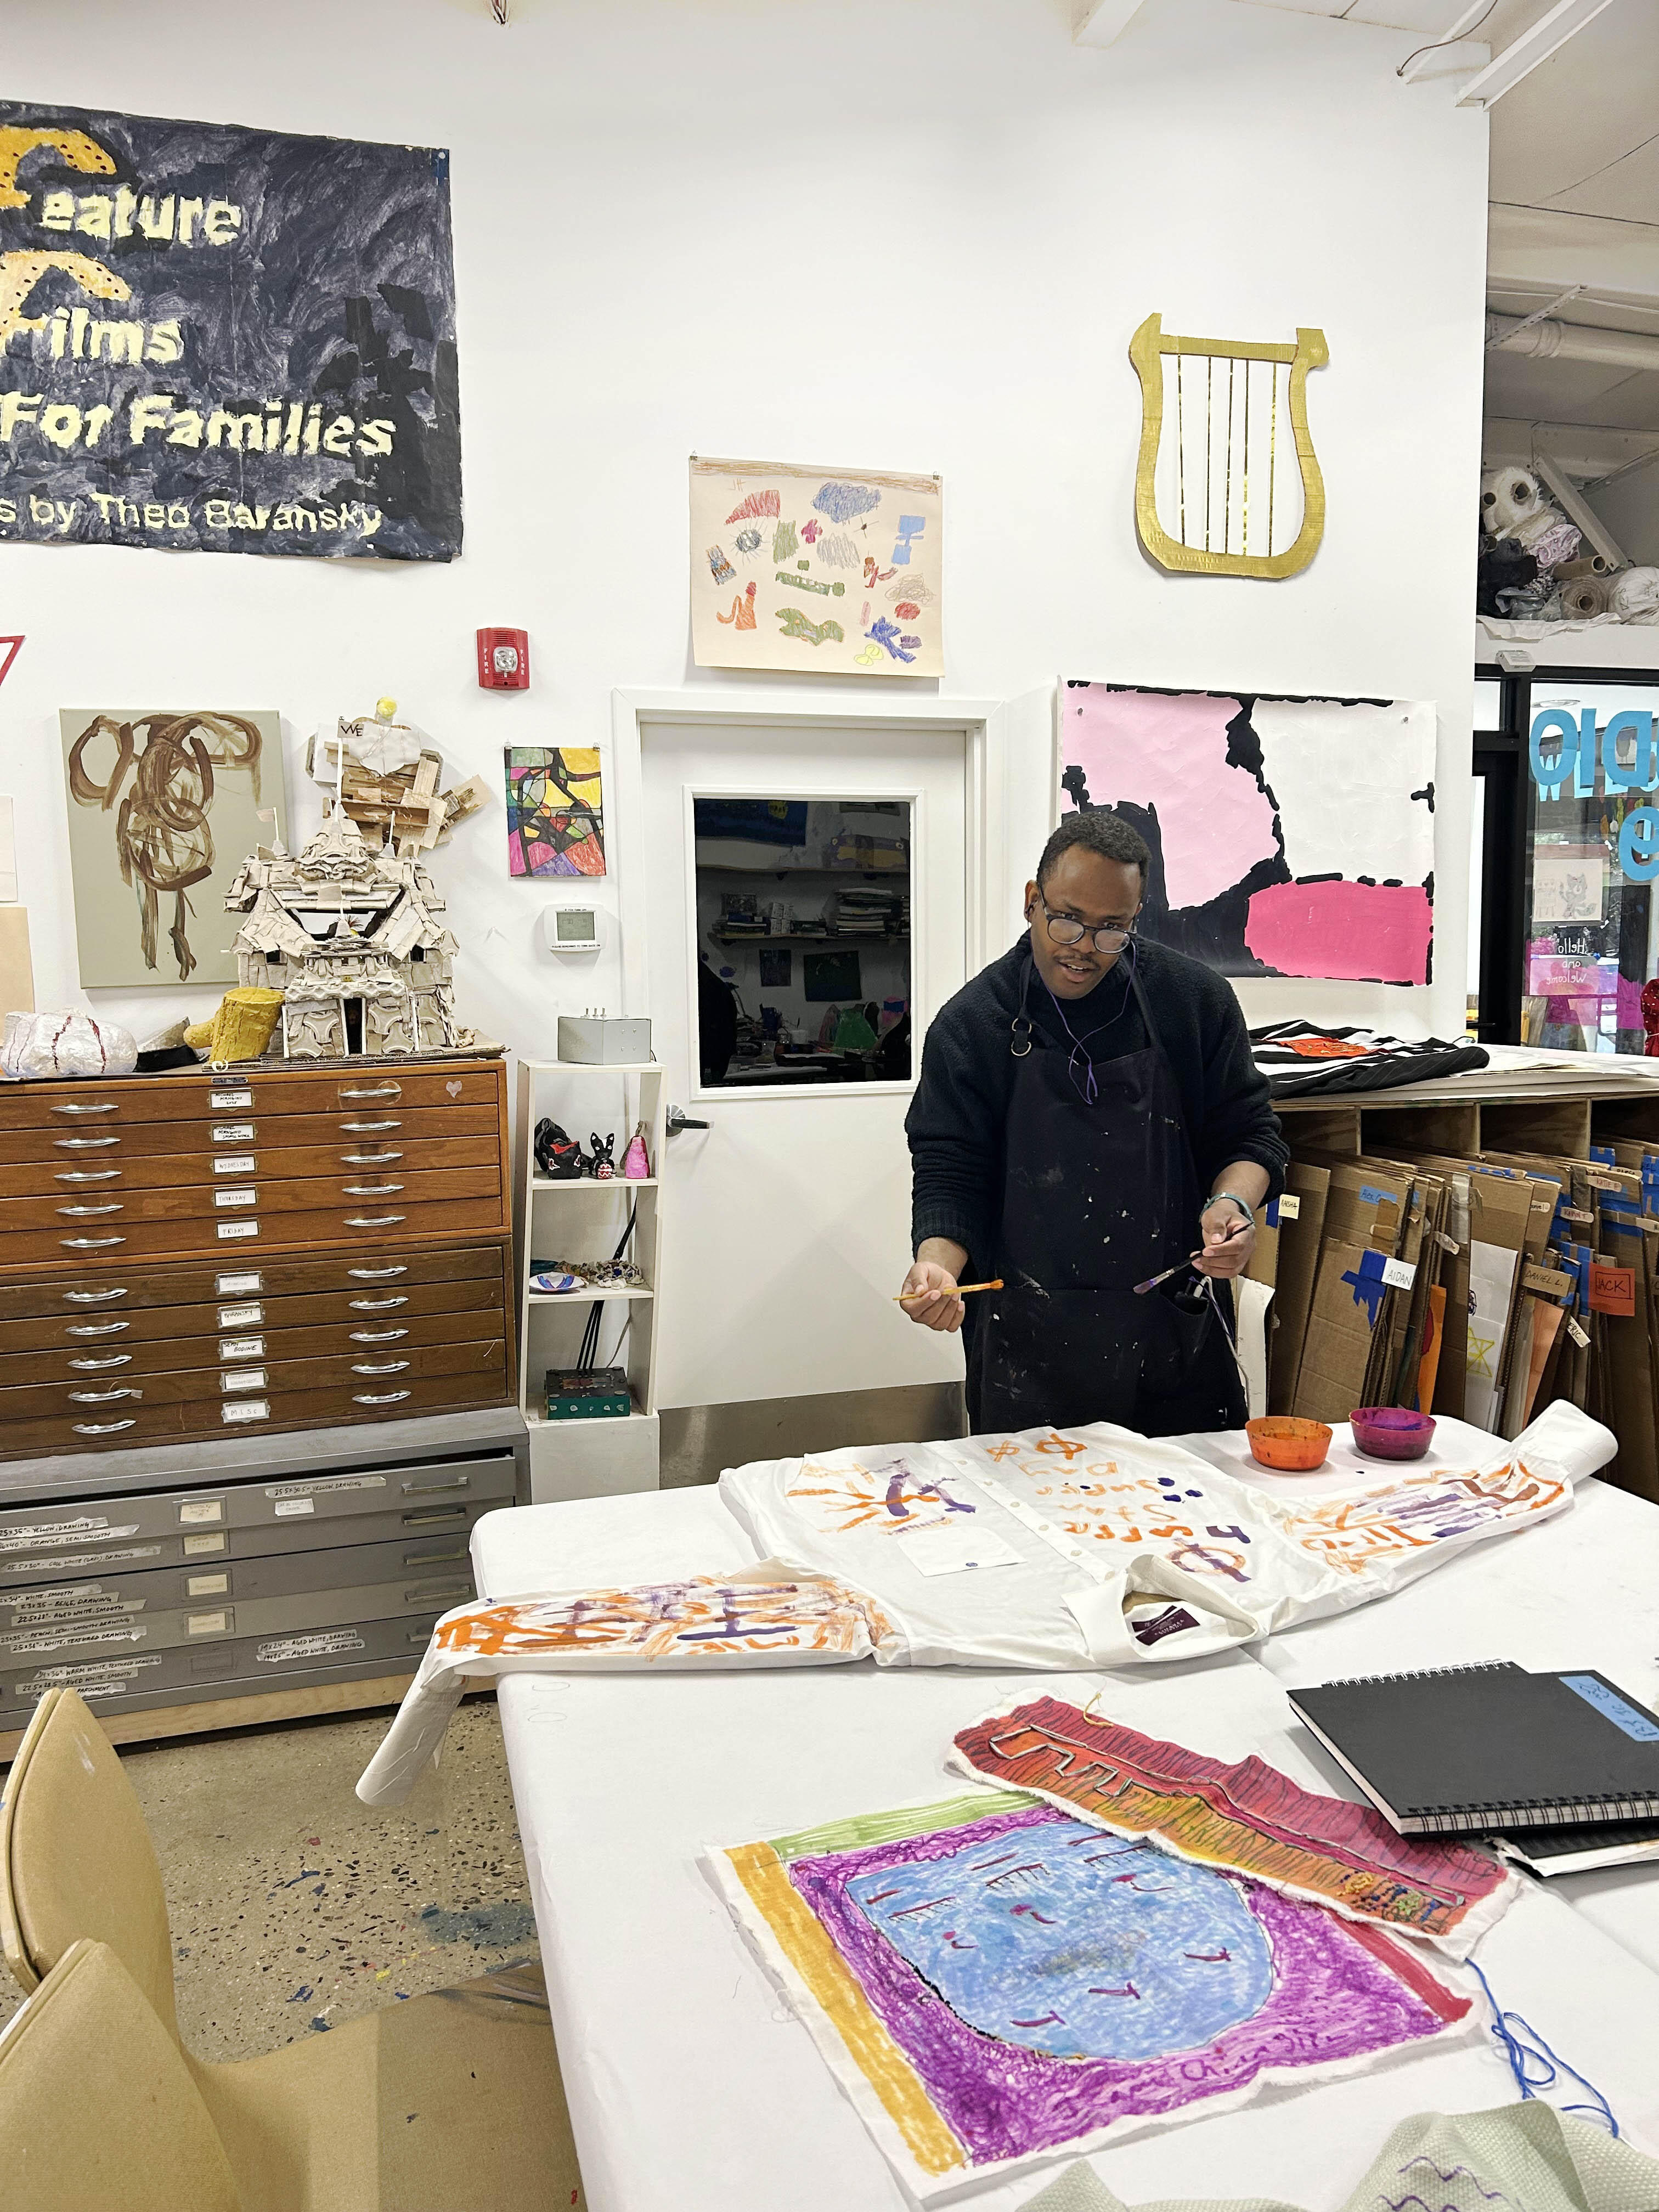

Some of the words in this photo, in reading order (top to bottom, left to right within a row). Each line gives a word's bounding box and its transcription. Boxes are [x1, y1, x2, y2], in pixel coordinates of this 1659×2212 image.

[0, 391, 113, 448] For
[130, 394, 396, 456] Families
[30, 494, 77, 534] by
[90, 493, 190, 529] Theo
[204, 499, 381, 538] Baransky
[340, 724, 363, 736] WE
[219, 1161, 249, 1170] WEDNESDAY
[223, 1227, 244, 1235] FRIDAY
[1387, 1269, 1412, 1285] AIDAN
[1525, 1269, 1551, 1284] DANIEL
[1597, 1278, 1626, 1293] JACK
[224, 1310, 252, 1318] BARANSKY
[1567, 1323, 1582, 1339] ERIC
[59, 1522, 89, 1531] DRAWING
[83, 1532, 111, 1540] SMOOTH
[105, 1552, 134, 1560] DRAWING
[77, 1596, 111, 1605] DRAWING
[96, 1605, 124, 1613] SMOOTH
[67, 1635, 99, 1645] TEXTURED
[101, 1630, 133, 1640] DRAWING
[330, 1632, 356, 1641] DRAWING
[331, 1643, 362, 1651] DRAWING
[77, 1685, 111, 1693] PARCHMENT
